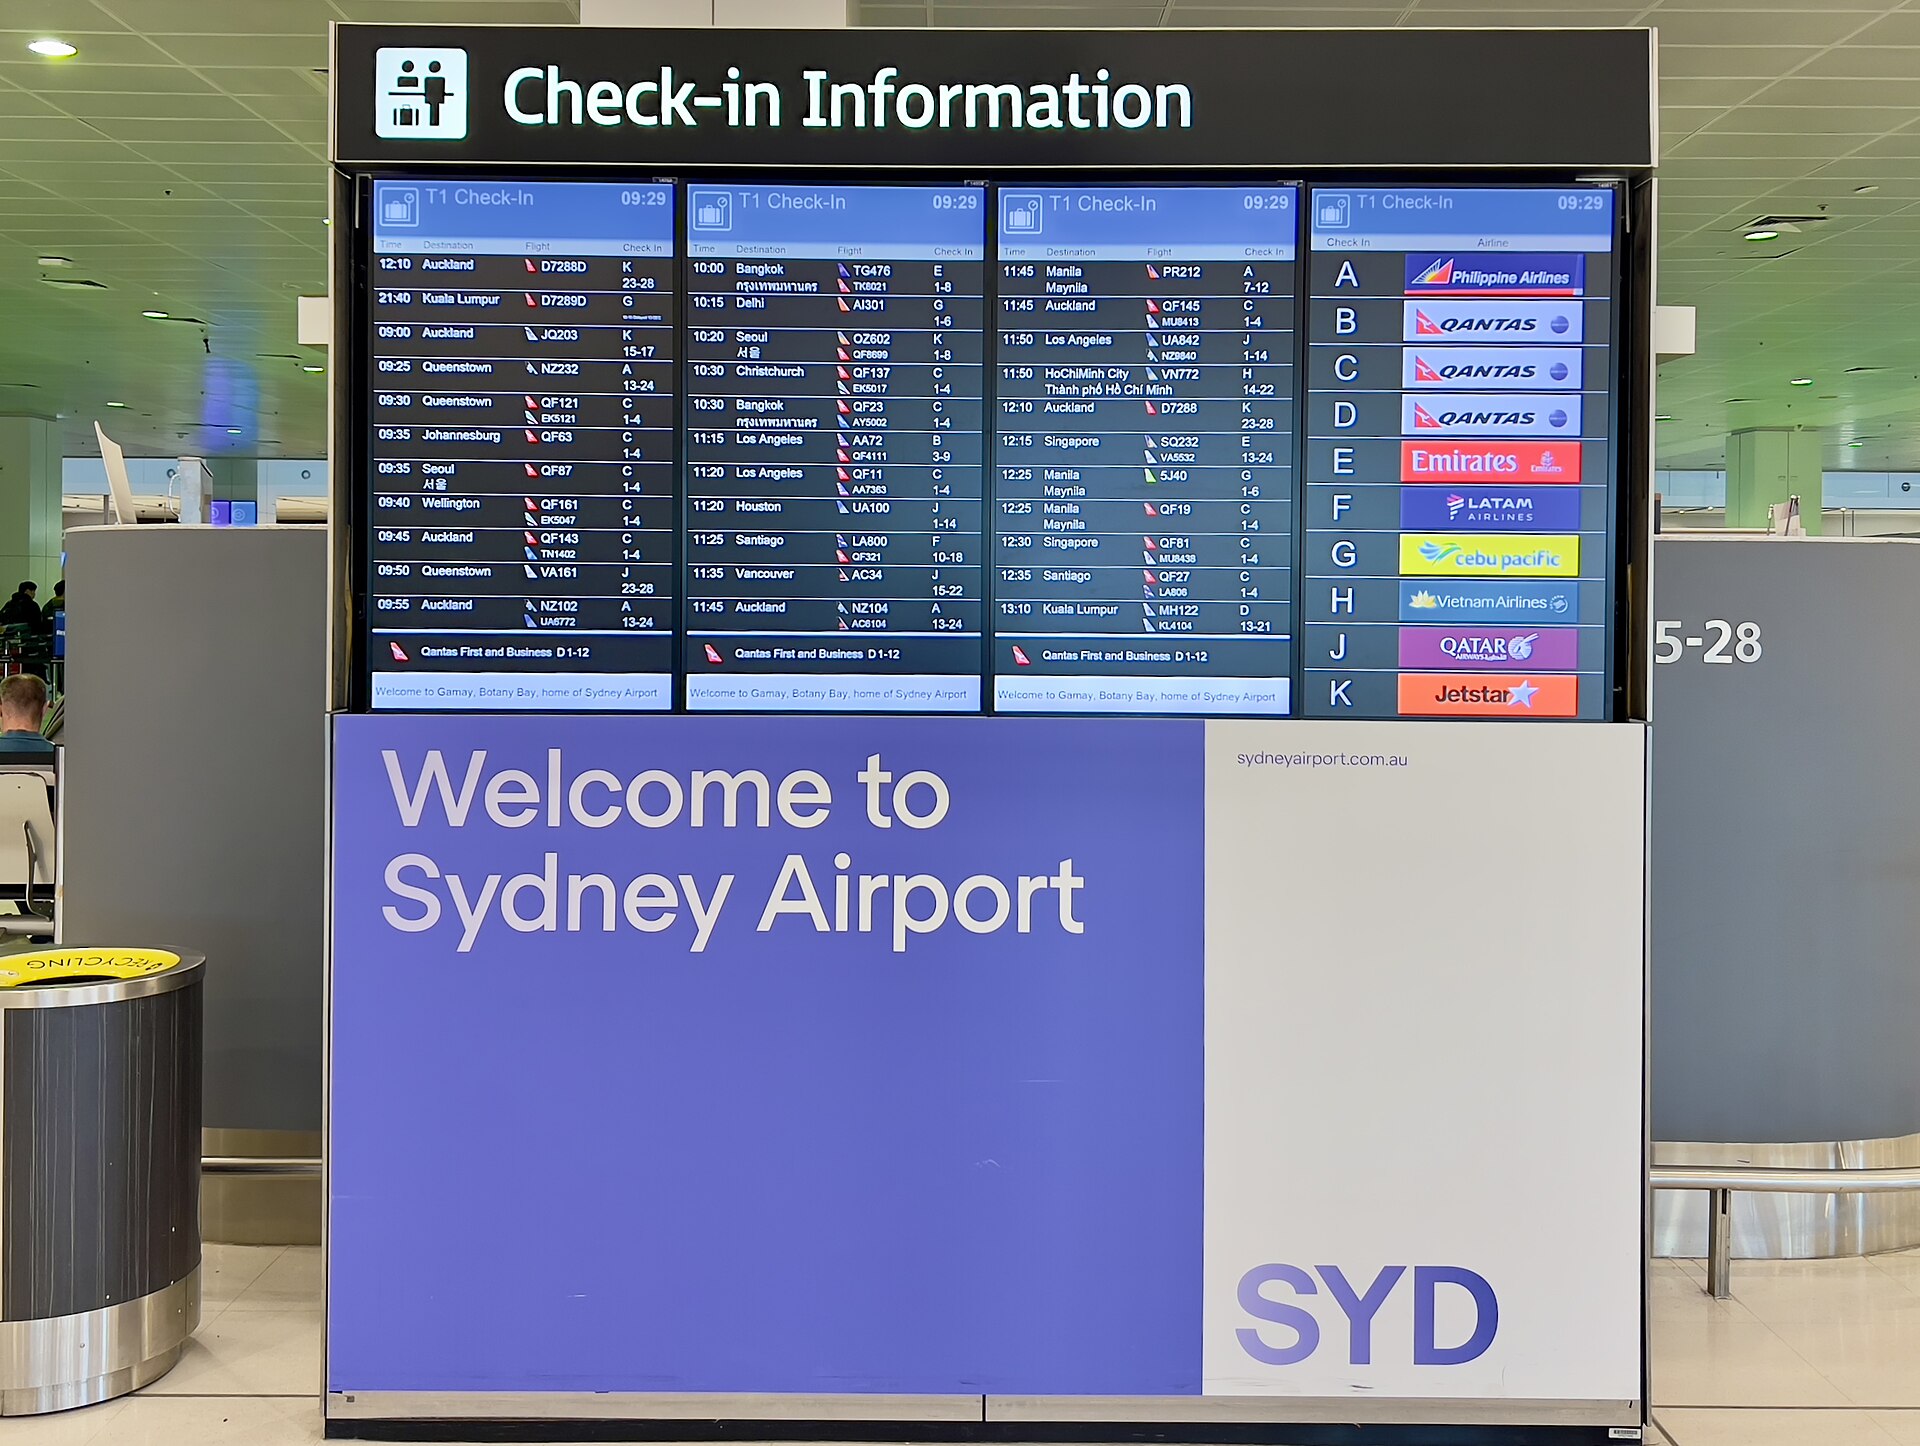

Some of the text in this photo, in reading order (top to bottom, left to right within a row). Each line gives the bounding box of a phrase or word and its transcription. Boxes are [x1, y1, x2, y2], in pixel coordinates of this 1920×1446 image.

[504, 65, 1190, 128] Check-in Information
[425, 188, 666, 205] T1 Check-In 09:29
[739, 193, 977, 209] T1 Check-In 09:29
[1357, 195, 1603, 210] T1 Check-In 09:29
[1049, 196, 1288, 211] T1 Check-In 09:29
[1327, 238, 1508, 247] Check In Airline
[380, 258, 586, 272] 12:10 Auckland D7288D
[694, 263, 890, 276] 10:00 Bangkok TG476
[1004, 266, 1200, 277] 11:45 Manila PR212
[1335, 261, 1569, 286] A Philippine Airlines
[1046, 282, 1087, 295] Maynila
[379, 292, 586, 306] 21:40 Kuala Lumpur D7289D
[694, 297, 883, 310] 10:15 Delhi AI301
[1004, 300, 1200, 311] 11:45 Auckland QF145
[1337, 308, 1355, 333] B
[1440, 319, 1536, 332] QANTAS
[379, 327, 578, 340] 09:00 Auckland JQ203
[694, 331, 890, 344] 10:20 Seoul OZ602
[737, 347, 760, 358] 서울
[694, 365, 890, 378] 10:30 Christchurch QF137
[1335, 355, 1536, 380] C QANTAS
[1003, 368, 1032, 378] 11:50
[1108, 368, 1129, 381] City
[1161, 369, 1199, 379] VN772
[1146, 385, 1172, 395] Minh
[379, 395, 577, 408] 09:30 Queenstown QF121
[1003, 402, 1197, 413] 12:10 Auckland D7288
[1335, 402, 1535, 427] D QANTAS
[379, 429, 572, 443] 09:35 Johannesburg QF63
[694, 433, 882, 446] 11:15 Los Angeles AA72
[1003, 436, 1198, 448] 12:15 Singapore SQ232
[1334, 448, 1516, 473] E Emirates
[379, 463, 572, 476] 09:35 Seoul QF87
[1003, 469, 1187, 480] 12:25 Manila 5J40
[423, 479, 446, 490] 서울
[1045, 486, 1085, 498] Maynila
[379, 497, 577, 510] 09:40 Wellington QF161
[694, 501, 889, 513] 11:20 Houston UA100
[1334, 495, 1532, 520] F LATAM
[1468, 513, 1533, 521] AIRLINES
[379, 531, 578, 544] 09:45 Auckland QF143
[694, 534, 887, 547] 11:25 Santiago LA800
[1002, 537, 1188, 549] 12:30 Singapore QF81
[1332, 541, 1560, 570] G cebu pacific
[378, 565, 576, 577] 09:50 Queenstown VA161
[694, 568, 882, 580] 11:35 Vancouver AC34
[1002, 570, 1190, 583] 12:35 Santiago QF27
[378, 599, 577, 611] 09:55 Auckland NZ102
[1332, 588, 1352, 613] H
[1437, 595, 1494, 608] Vietnam
[1496, 596, 1547, 608] Airlines
[693, 602, 888, 613] 11:45 Auckland NZ104
[1001, 604, 1198, 616] 13:10 Kuala Lumpur MH122
[1330, 634, 1506, 659] J QATAR
[1331, 680, 1509, 705] K Jetstar
[1238, 751, 1407, 768] sydneyairport.com.au
[382, 749, 949, 828] Welcome to
[382, 853, 1084, 952] Sydney Airport
[27, 957, 148, 969] RECYCLING
[1236, 1264, 1498, 1365] SYD
